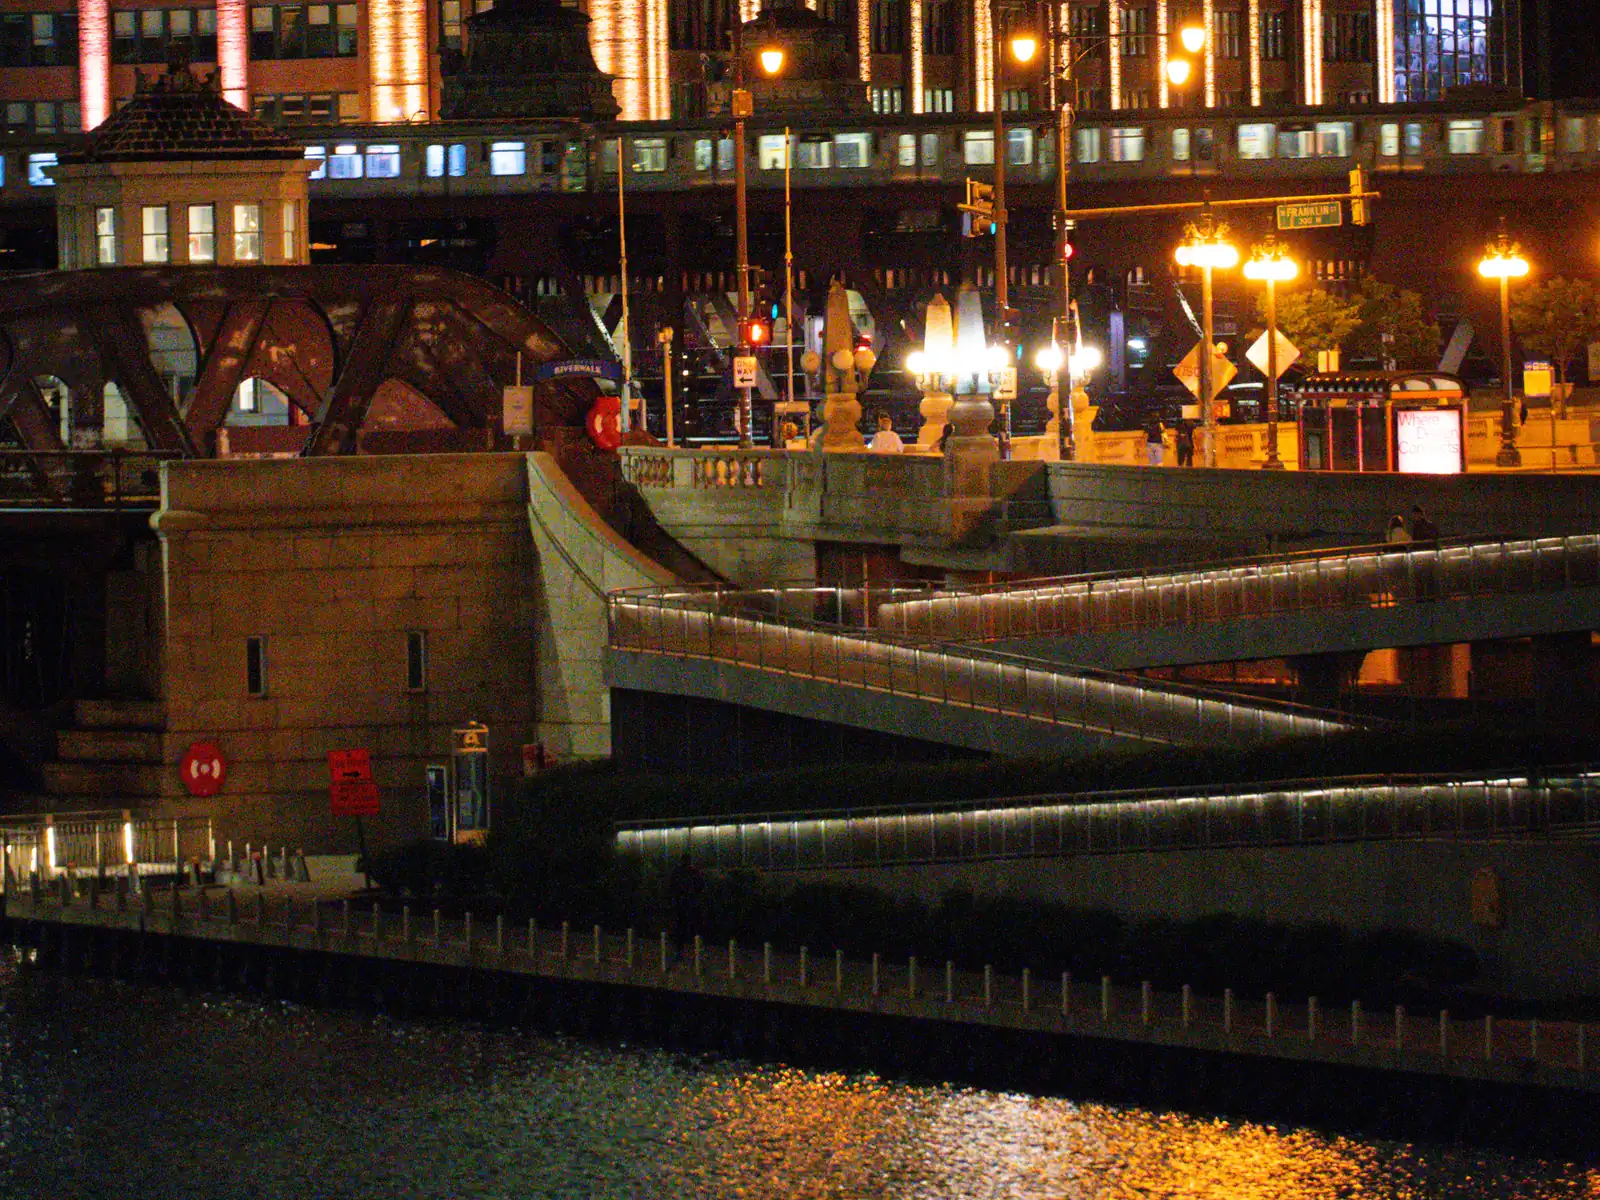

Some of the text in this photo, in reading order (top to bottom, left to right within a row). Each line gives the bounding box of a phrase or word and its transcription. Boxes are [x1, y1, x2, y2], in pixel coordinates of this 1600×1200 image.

[1287, 205, 1329, 217] FRANKLIN
[554, 364, 602, 374] RIVERWALK
[737, 360, 752, 368] ONE
[1399, 412, 1439, 426] Where
[1399, 440, 1459, 455] Concts
